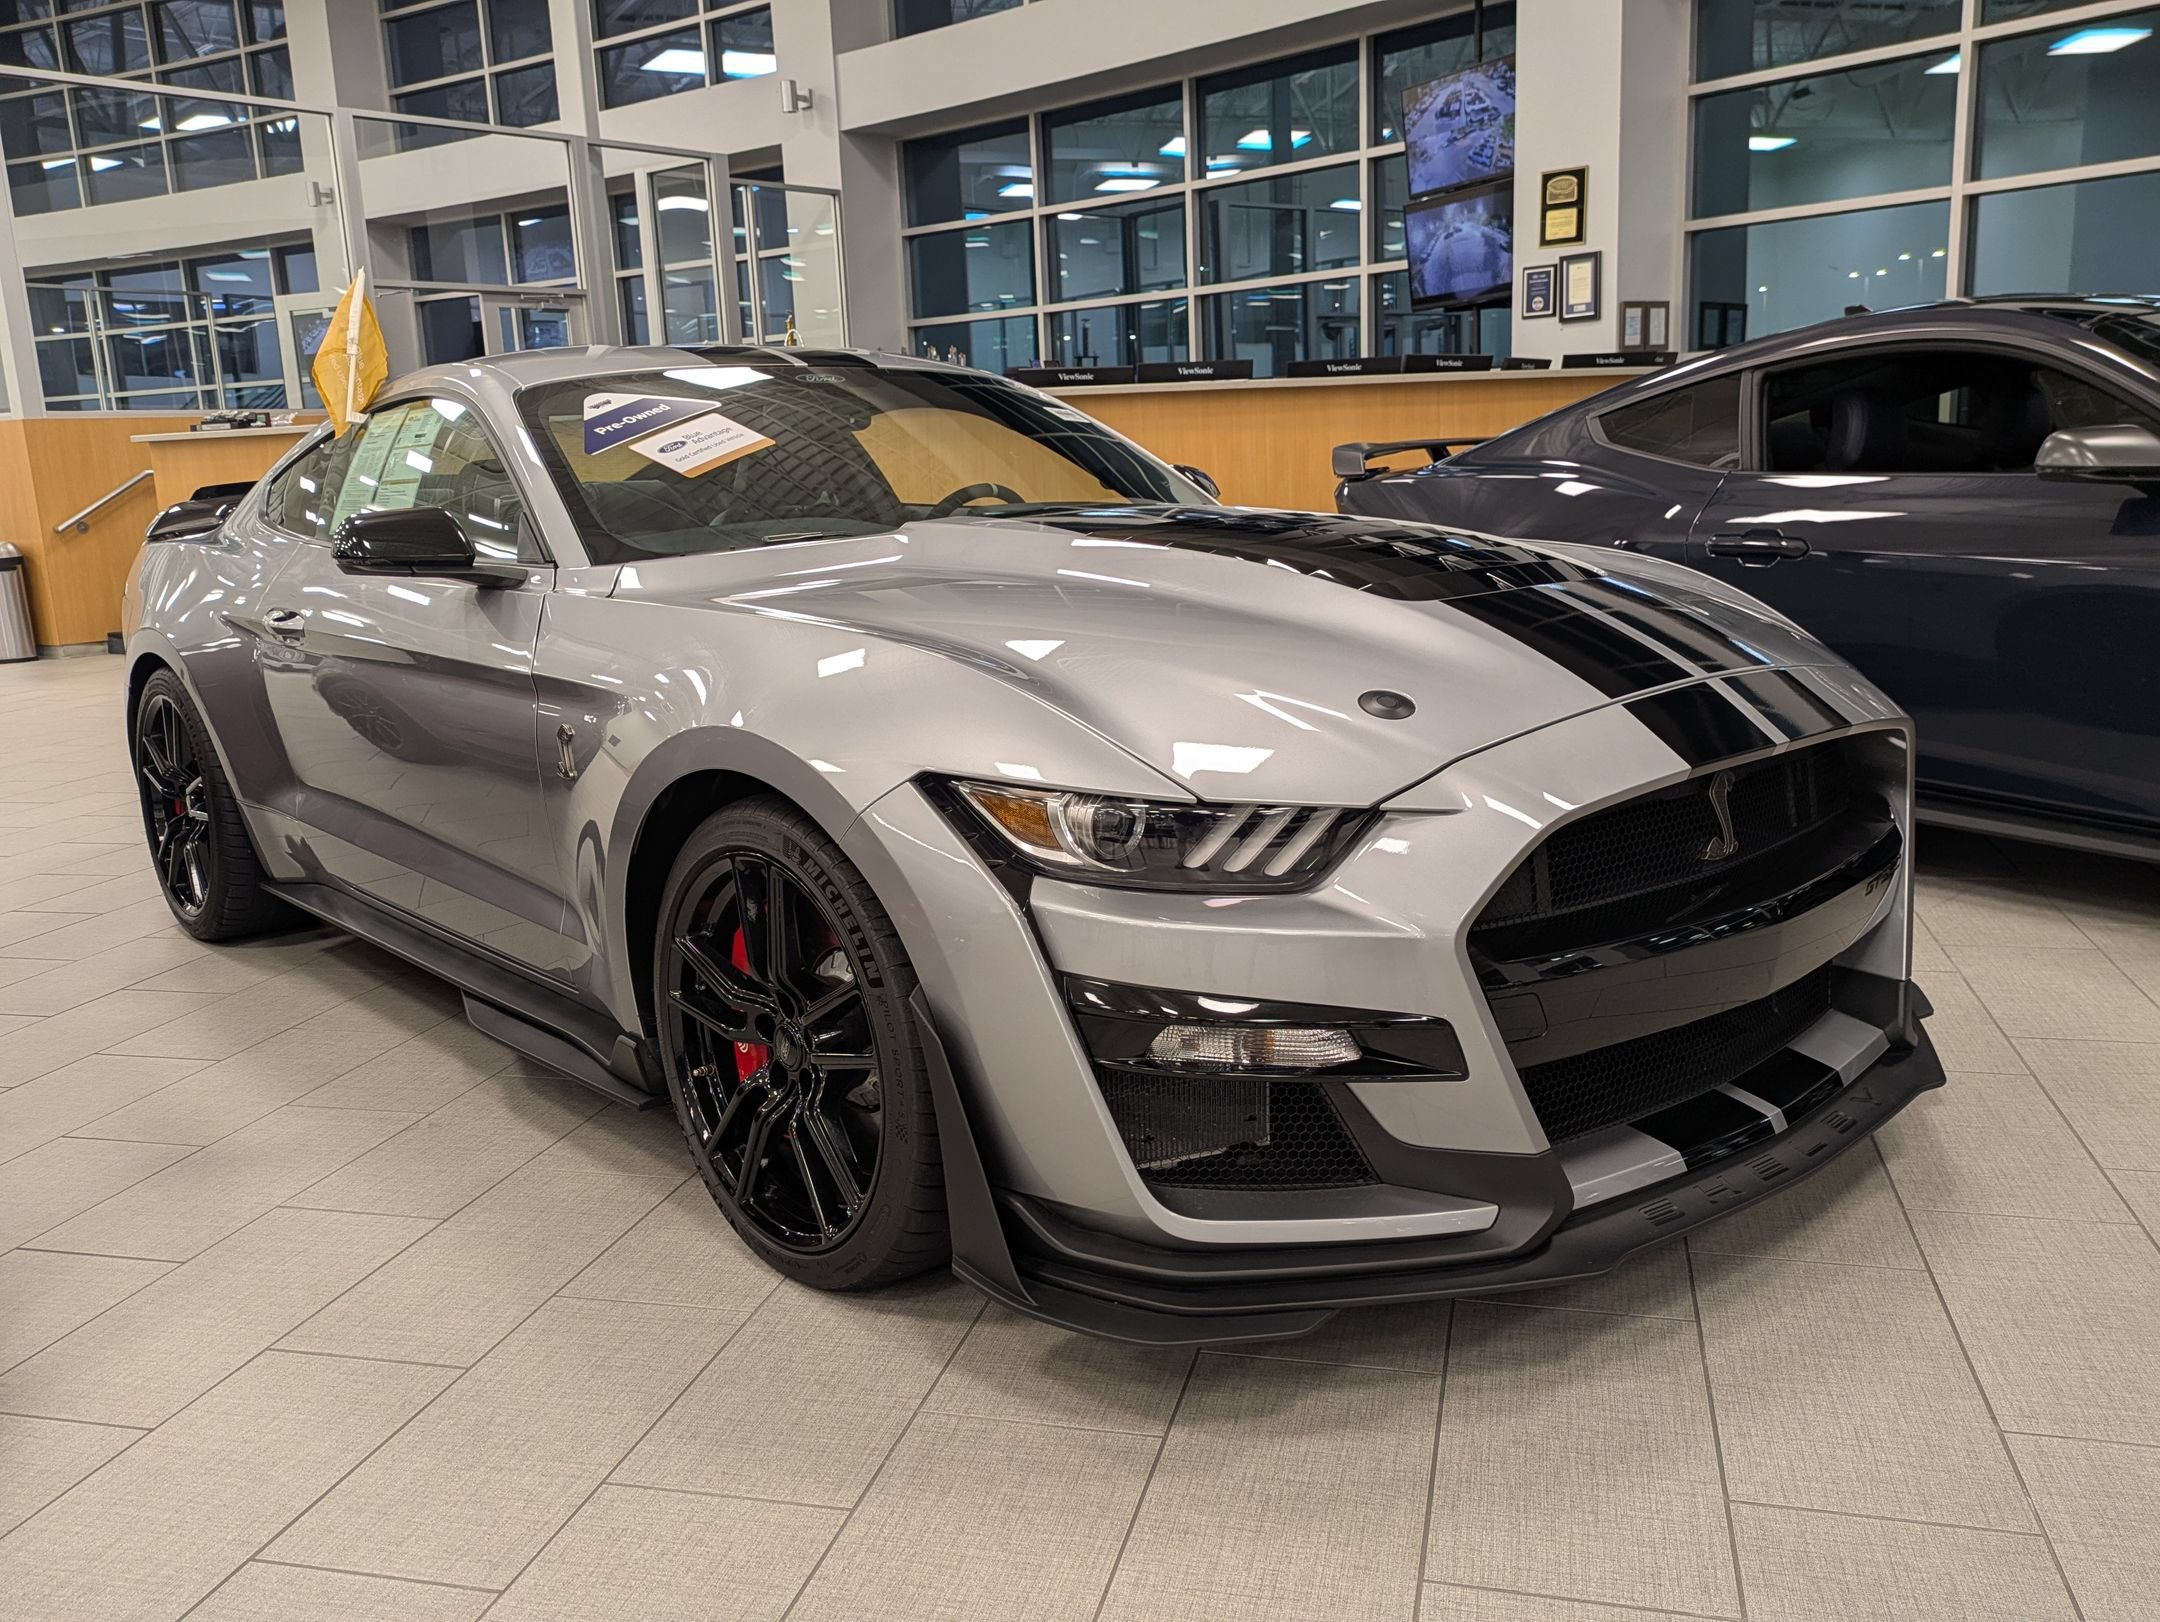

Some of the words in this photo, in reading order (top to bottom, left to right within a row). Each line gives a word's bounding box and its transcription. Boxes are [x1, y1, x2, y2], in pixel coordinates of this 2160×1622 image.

[1177, 366, 1214, 376] ViewSonic
[1326, 363, 1362, 373] ViewSonic
[1058, 372, 1095, 382] ViewSonic
[593, 403, 672, 436] Pre-Owned
[681, 430, 702, 441] Blue
[691, 427, 733, 445] Advantage
[662, 441, 684, 453] Ford
[803, 858, 881, 980] MICHELIN
[879, 998, 896, 1041] PILOT
[891, 1050, 906, 1099] SPORT
[1638, 1087, 1883, 1227] SHELBY
